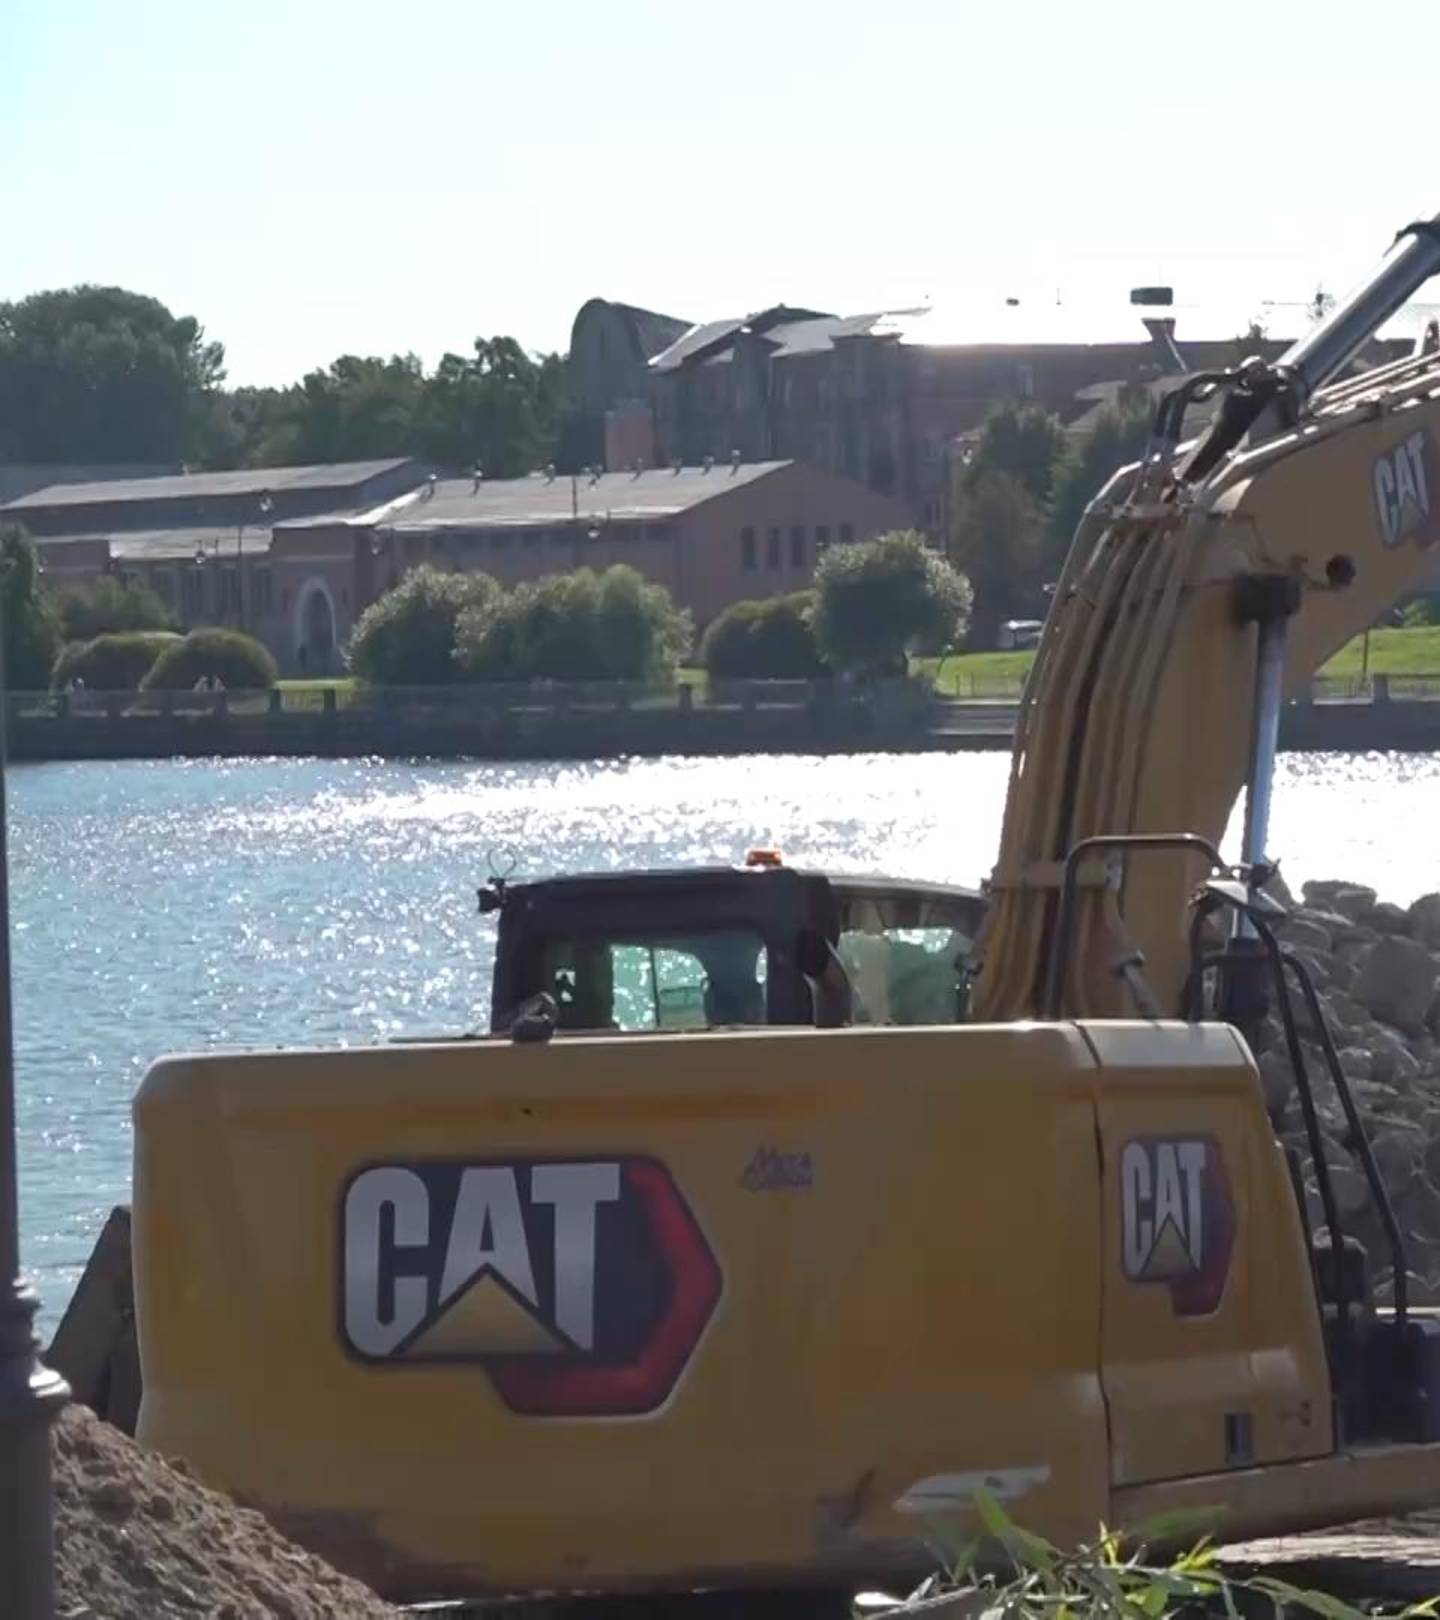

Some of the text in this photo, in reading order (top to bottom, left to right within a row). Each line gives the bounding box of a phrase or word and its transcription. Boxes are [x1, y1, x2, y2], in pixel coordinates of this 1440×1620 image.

[1374, 431, 1430, 544] CAT
[344, 1162, 621, 1358] CAT
[1121, 1142, 1206, 1277] CAT
